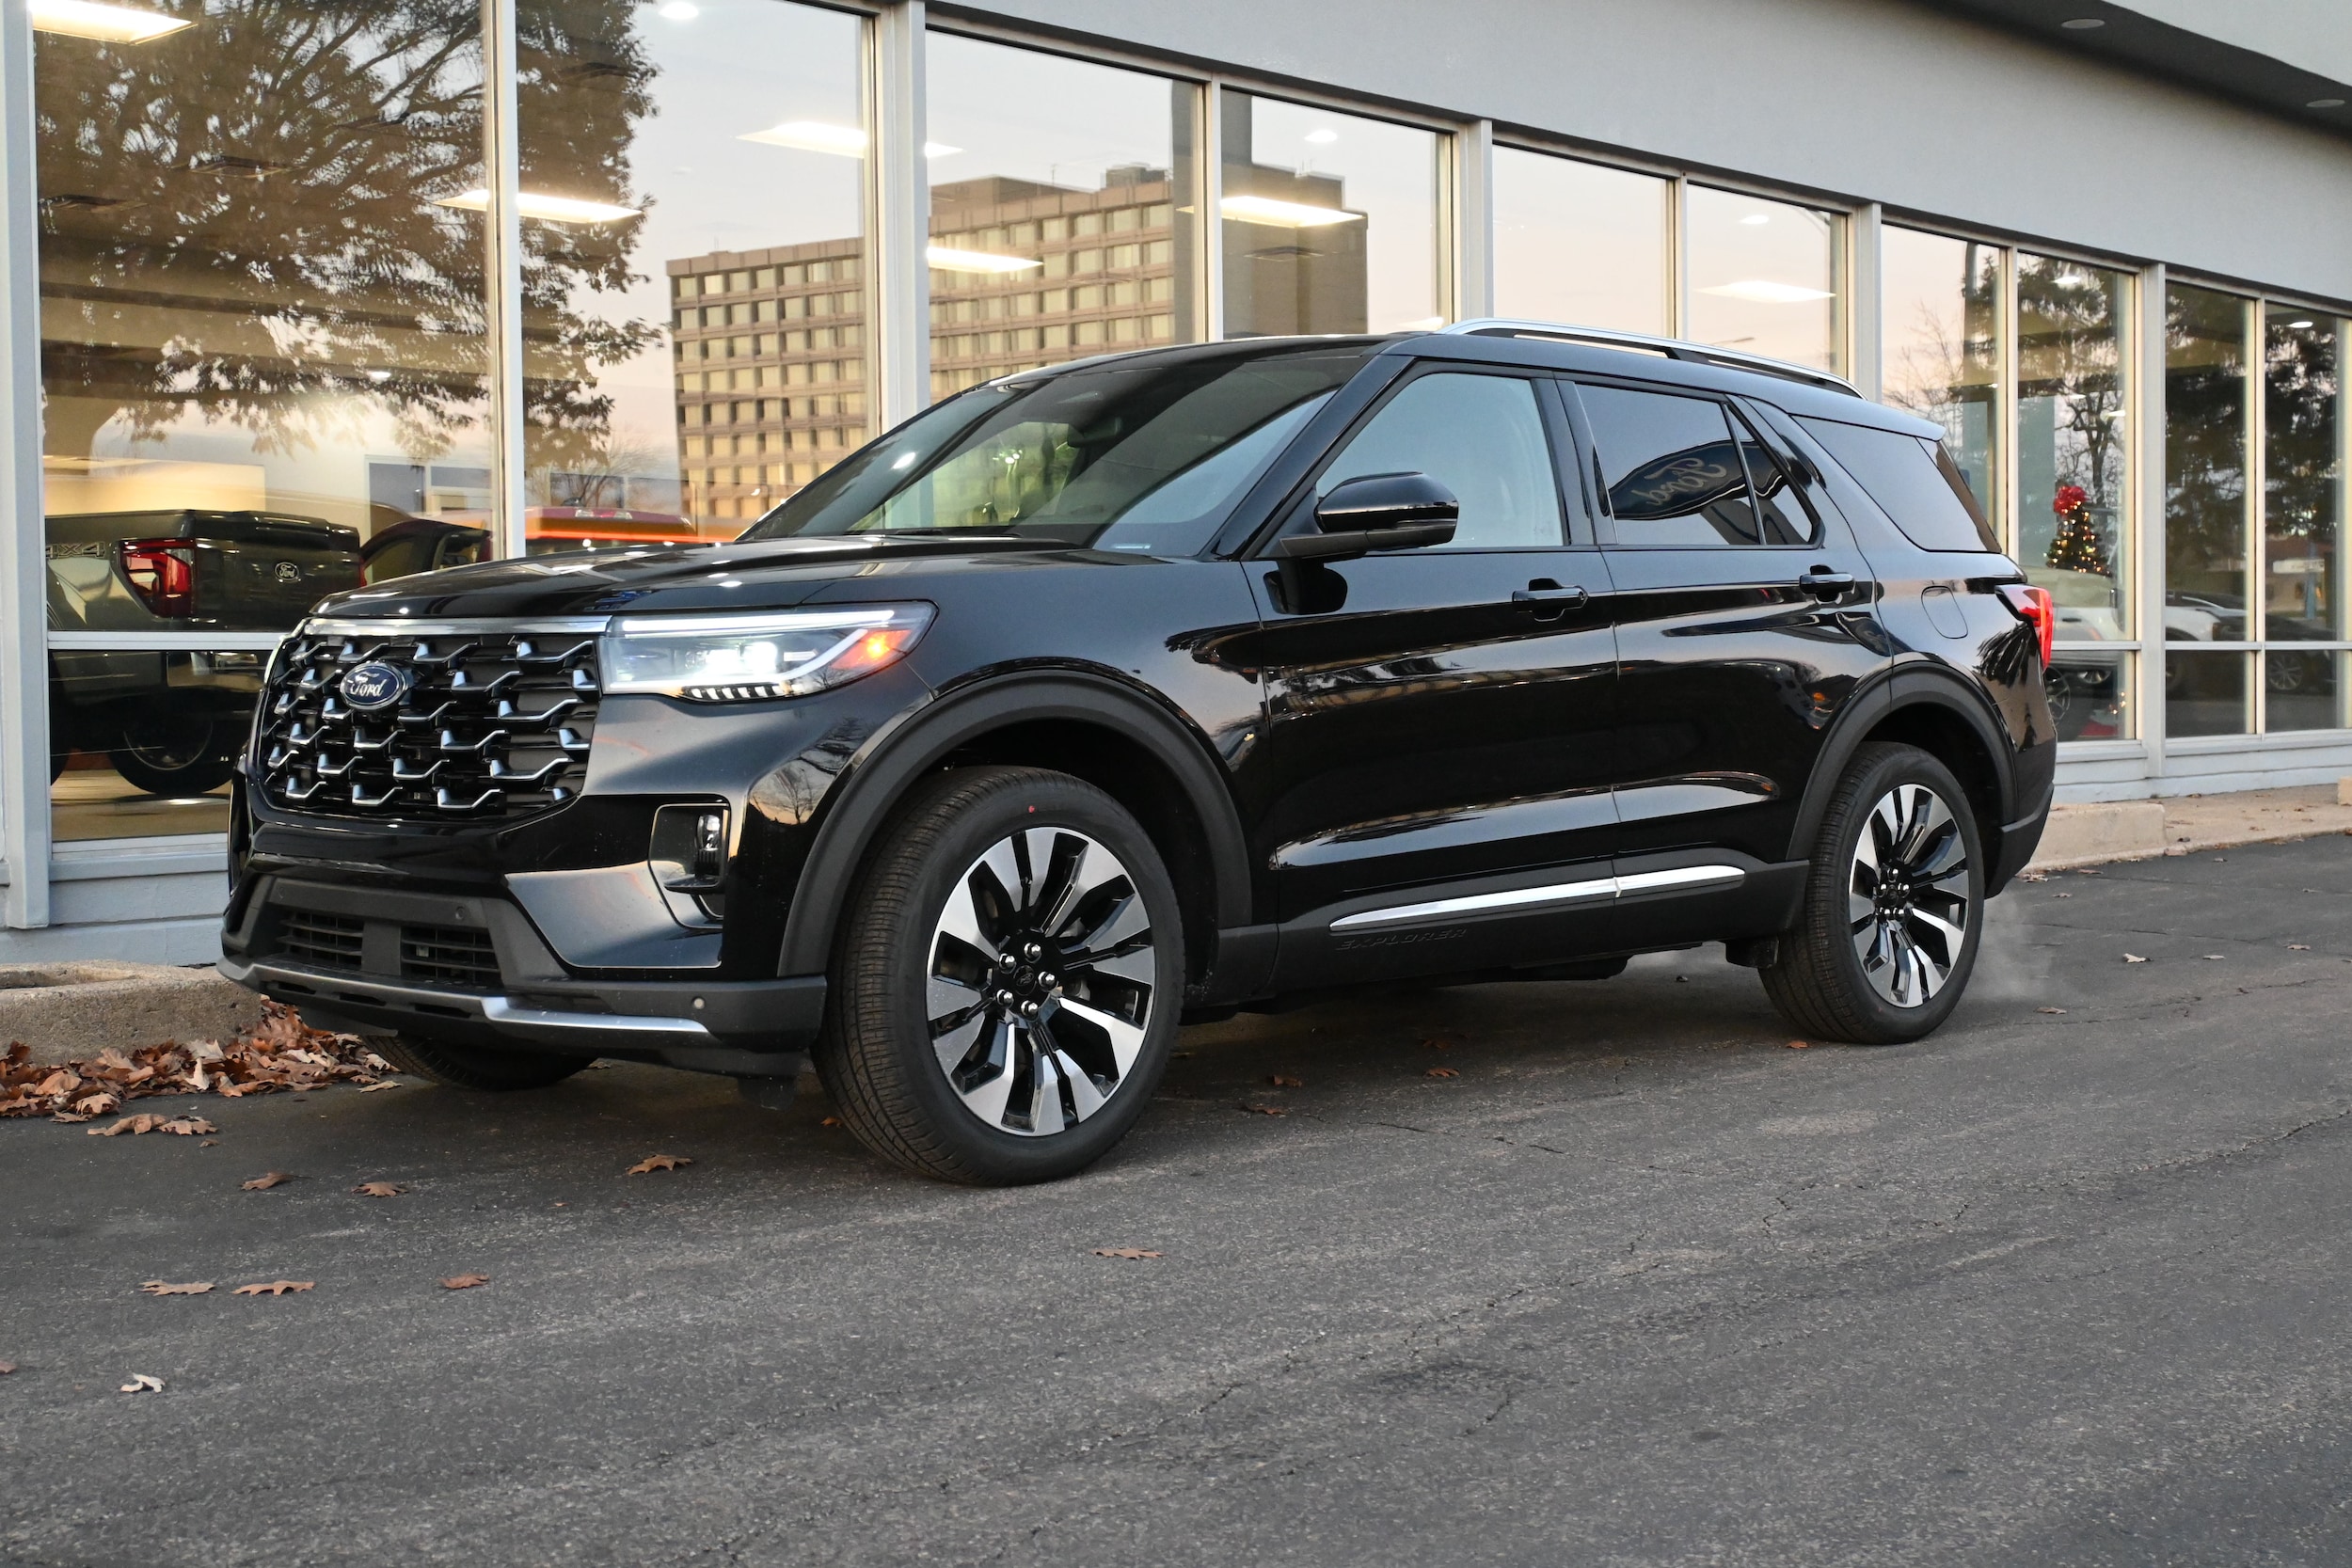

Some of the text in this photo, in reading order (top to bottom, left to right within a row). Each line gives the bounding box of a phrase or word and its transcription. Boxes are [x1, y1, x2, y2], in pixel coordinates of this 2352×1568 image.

[278, 563, 295, 578] Ford
[349, 671, 388, 697] Ford
[1335, 928, 1468, 951] EXPLORER
